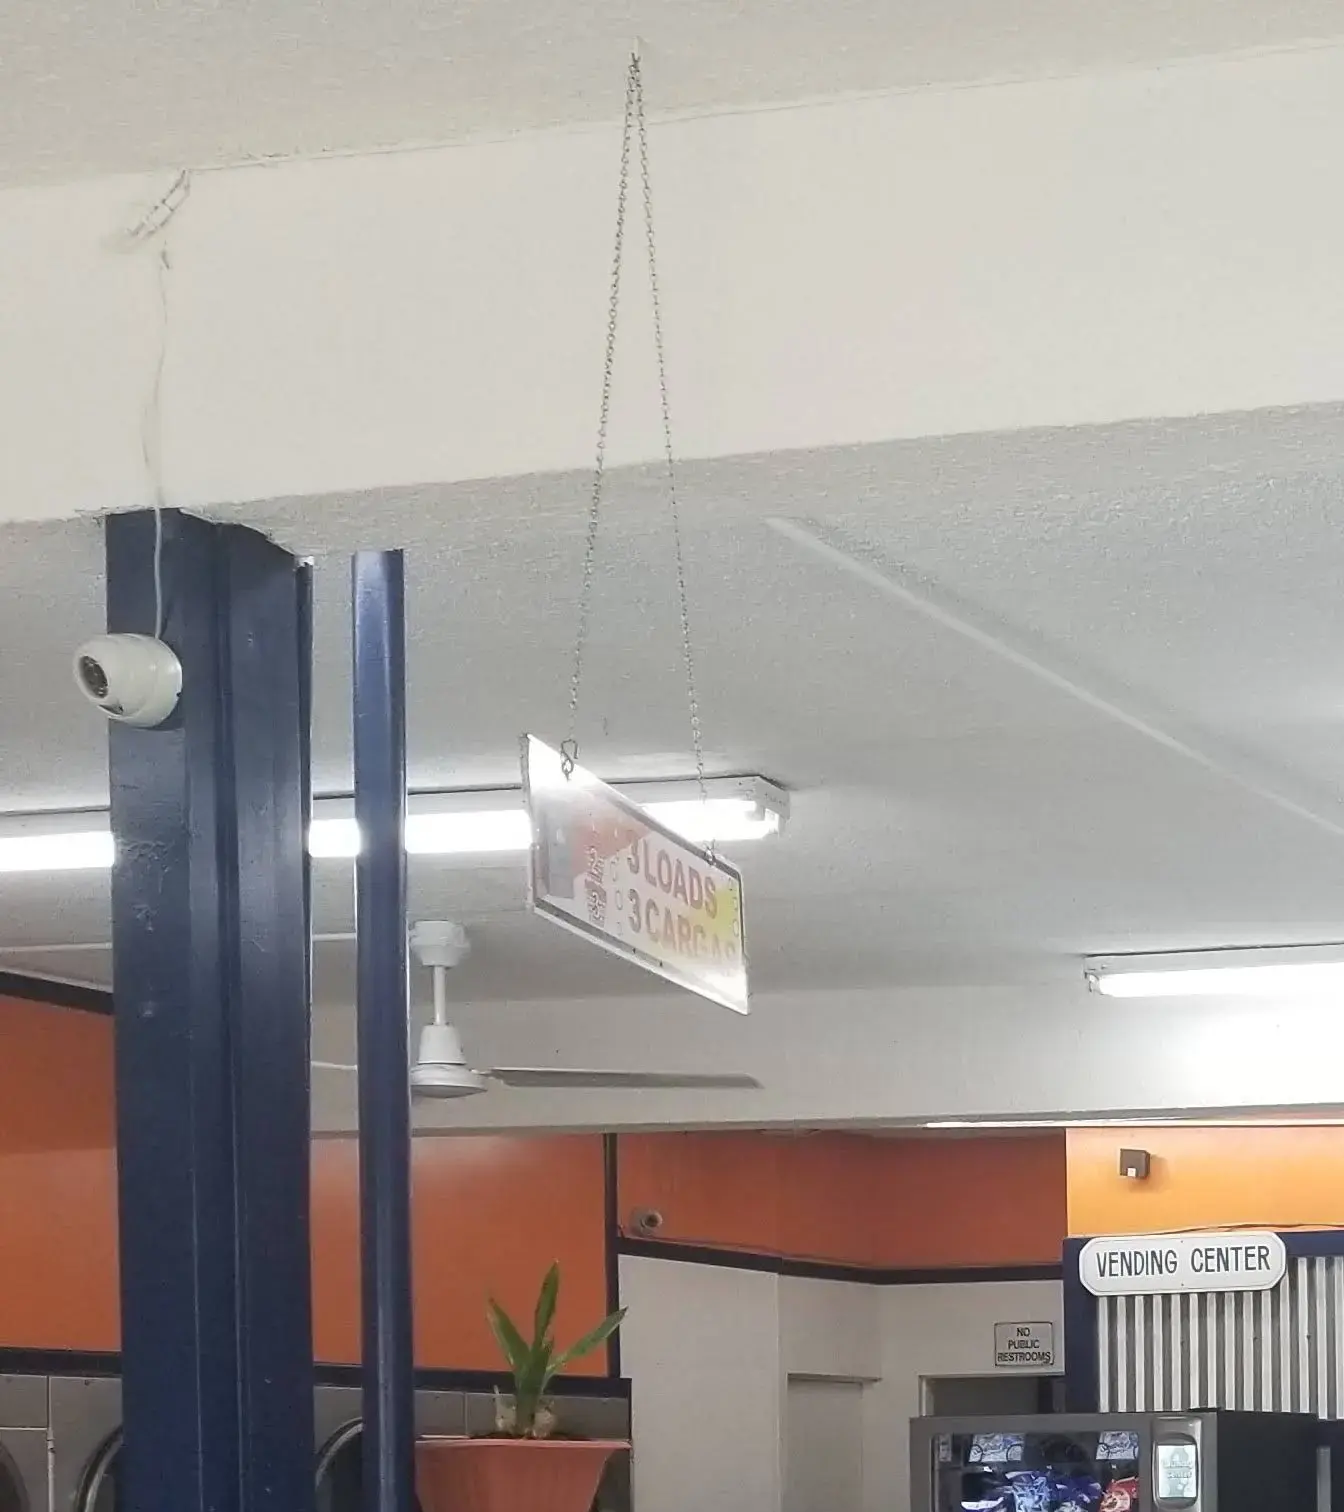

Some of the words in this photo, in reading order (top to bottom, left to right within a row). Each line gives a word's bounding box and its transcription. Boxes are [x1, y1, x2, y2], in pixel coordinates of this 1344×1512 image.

[643, 838, 718, 920] LOADS
[627, 888, 642, 934] 3
[1095, 1249, 1178, 1278] VENDING
[1190, 1245, 1271, 1273] CENTER
[1016, 1327, 1031, 1337] NO
[1008, 1339, 1040, 1350] PUBLIC
[997, 1351, 1052, 1362] RESTROOMS
